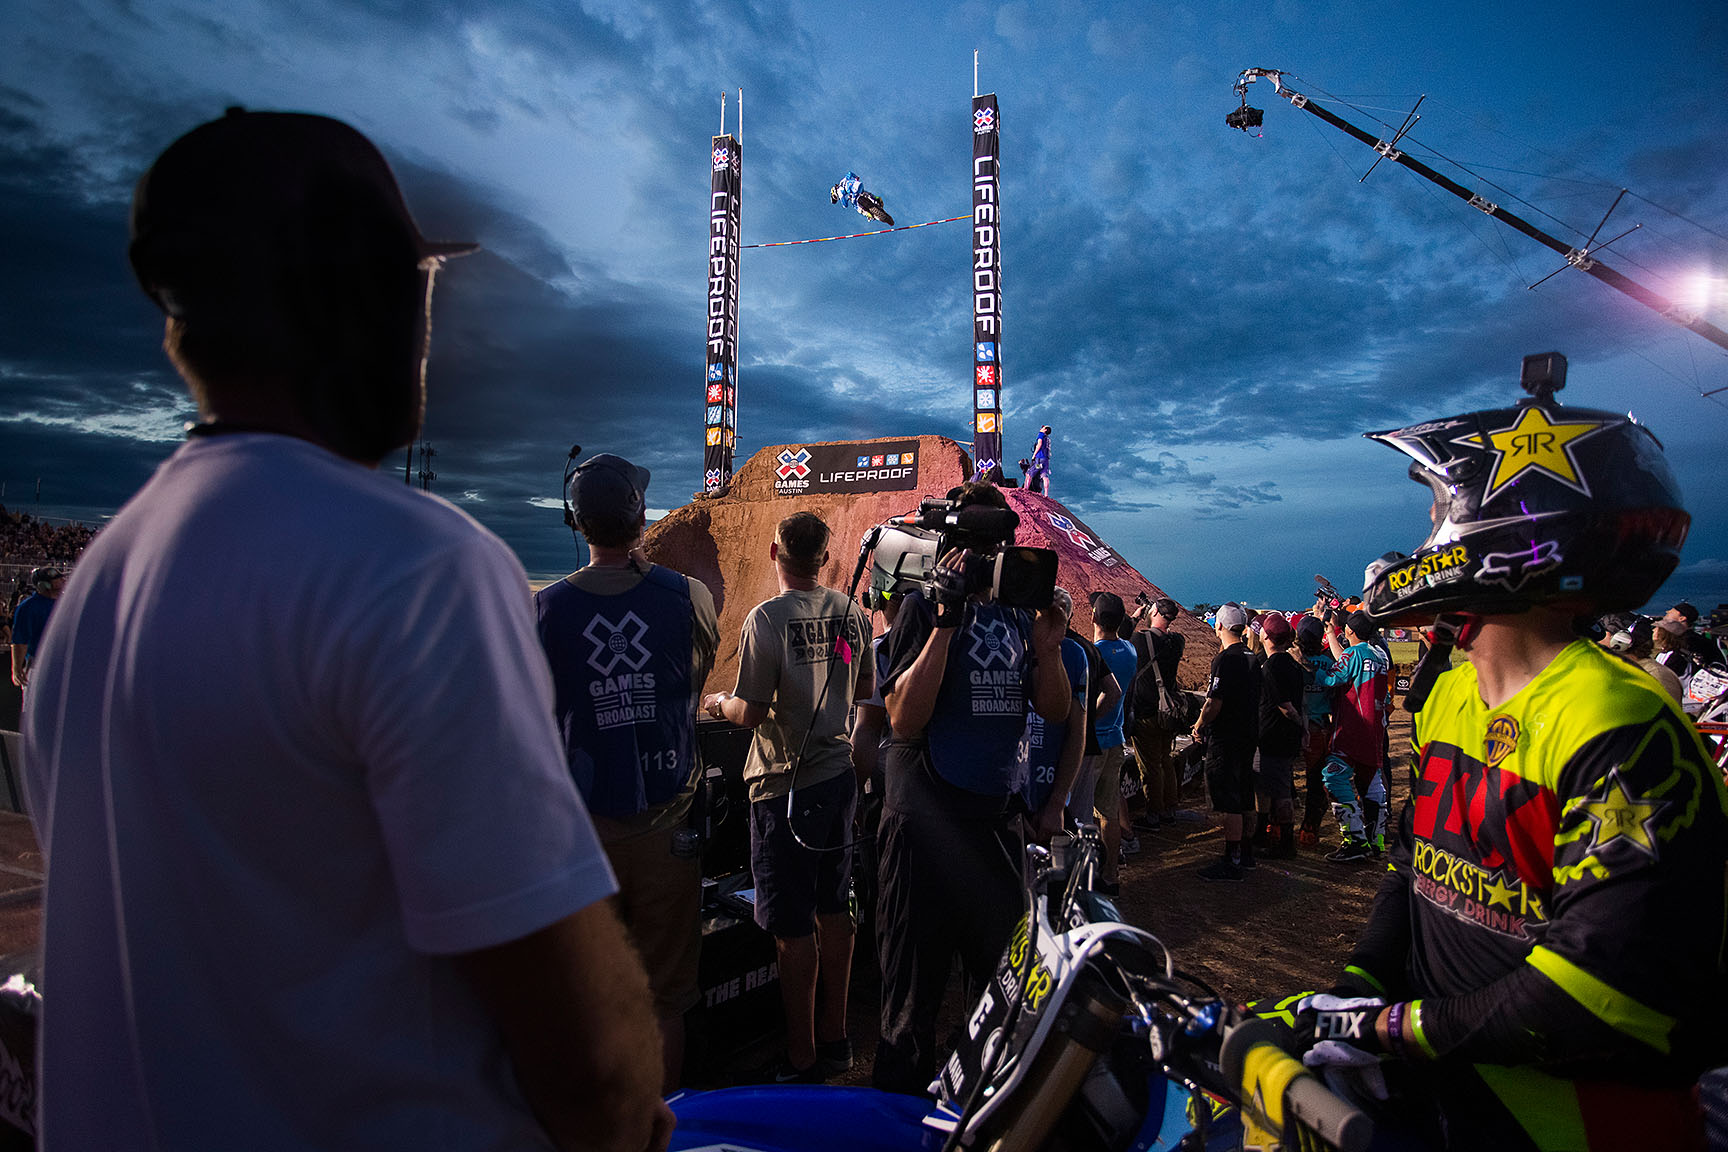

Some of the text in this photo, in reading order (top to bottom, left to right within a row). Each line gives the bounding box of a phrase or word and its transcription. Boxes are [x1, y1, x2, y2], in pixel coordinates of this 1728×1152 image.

[974, 155, 995, 335] LIFEPROOF
[707, 192, 728, 357] LIFEPROOF
[774, 479, 810, 489] GAMES
[819, 467, 914, 483] LIFEPROOF
[588, 672, 656, 697] GAMES
[969, 670, 1021, 685] GAMES
[618, 691, 633, 706] TV
[993, 686, 1006, 699] TV
[971, 699, 1023, 713] BROADCAST
[640, 749, 678, 772] 113
[1035, 765, 1056, 785] 26
[1464, 898, 1526, 936] DRINK
[704, 976, 742, 1009] THE
[1313, 1010, 1366, 1039] FOX
